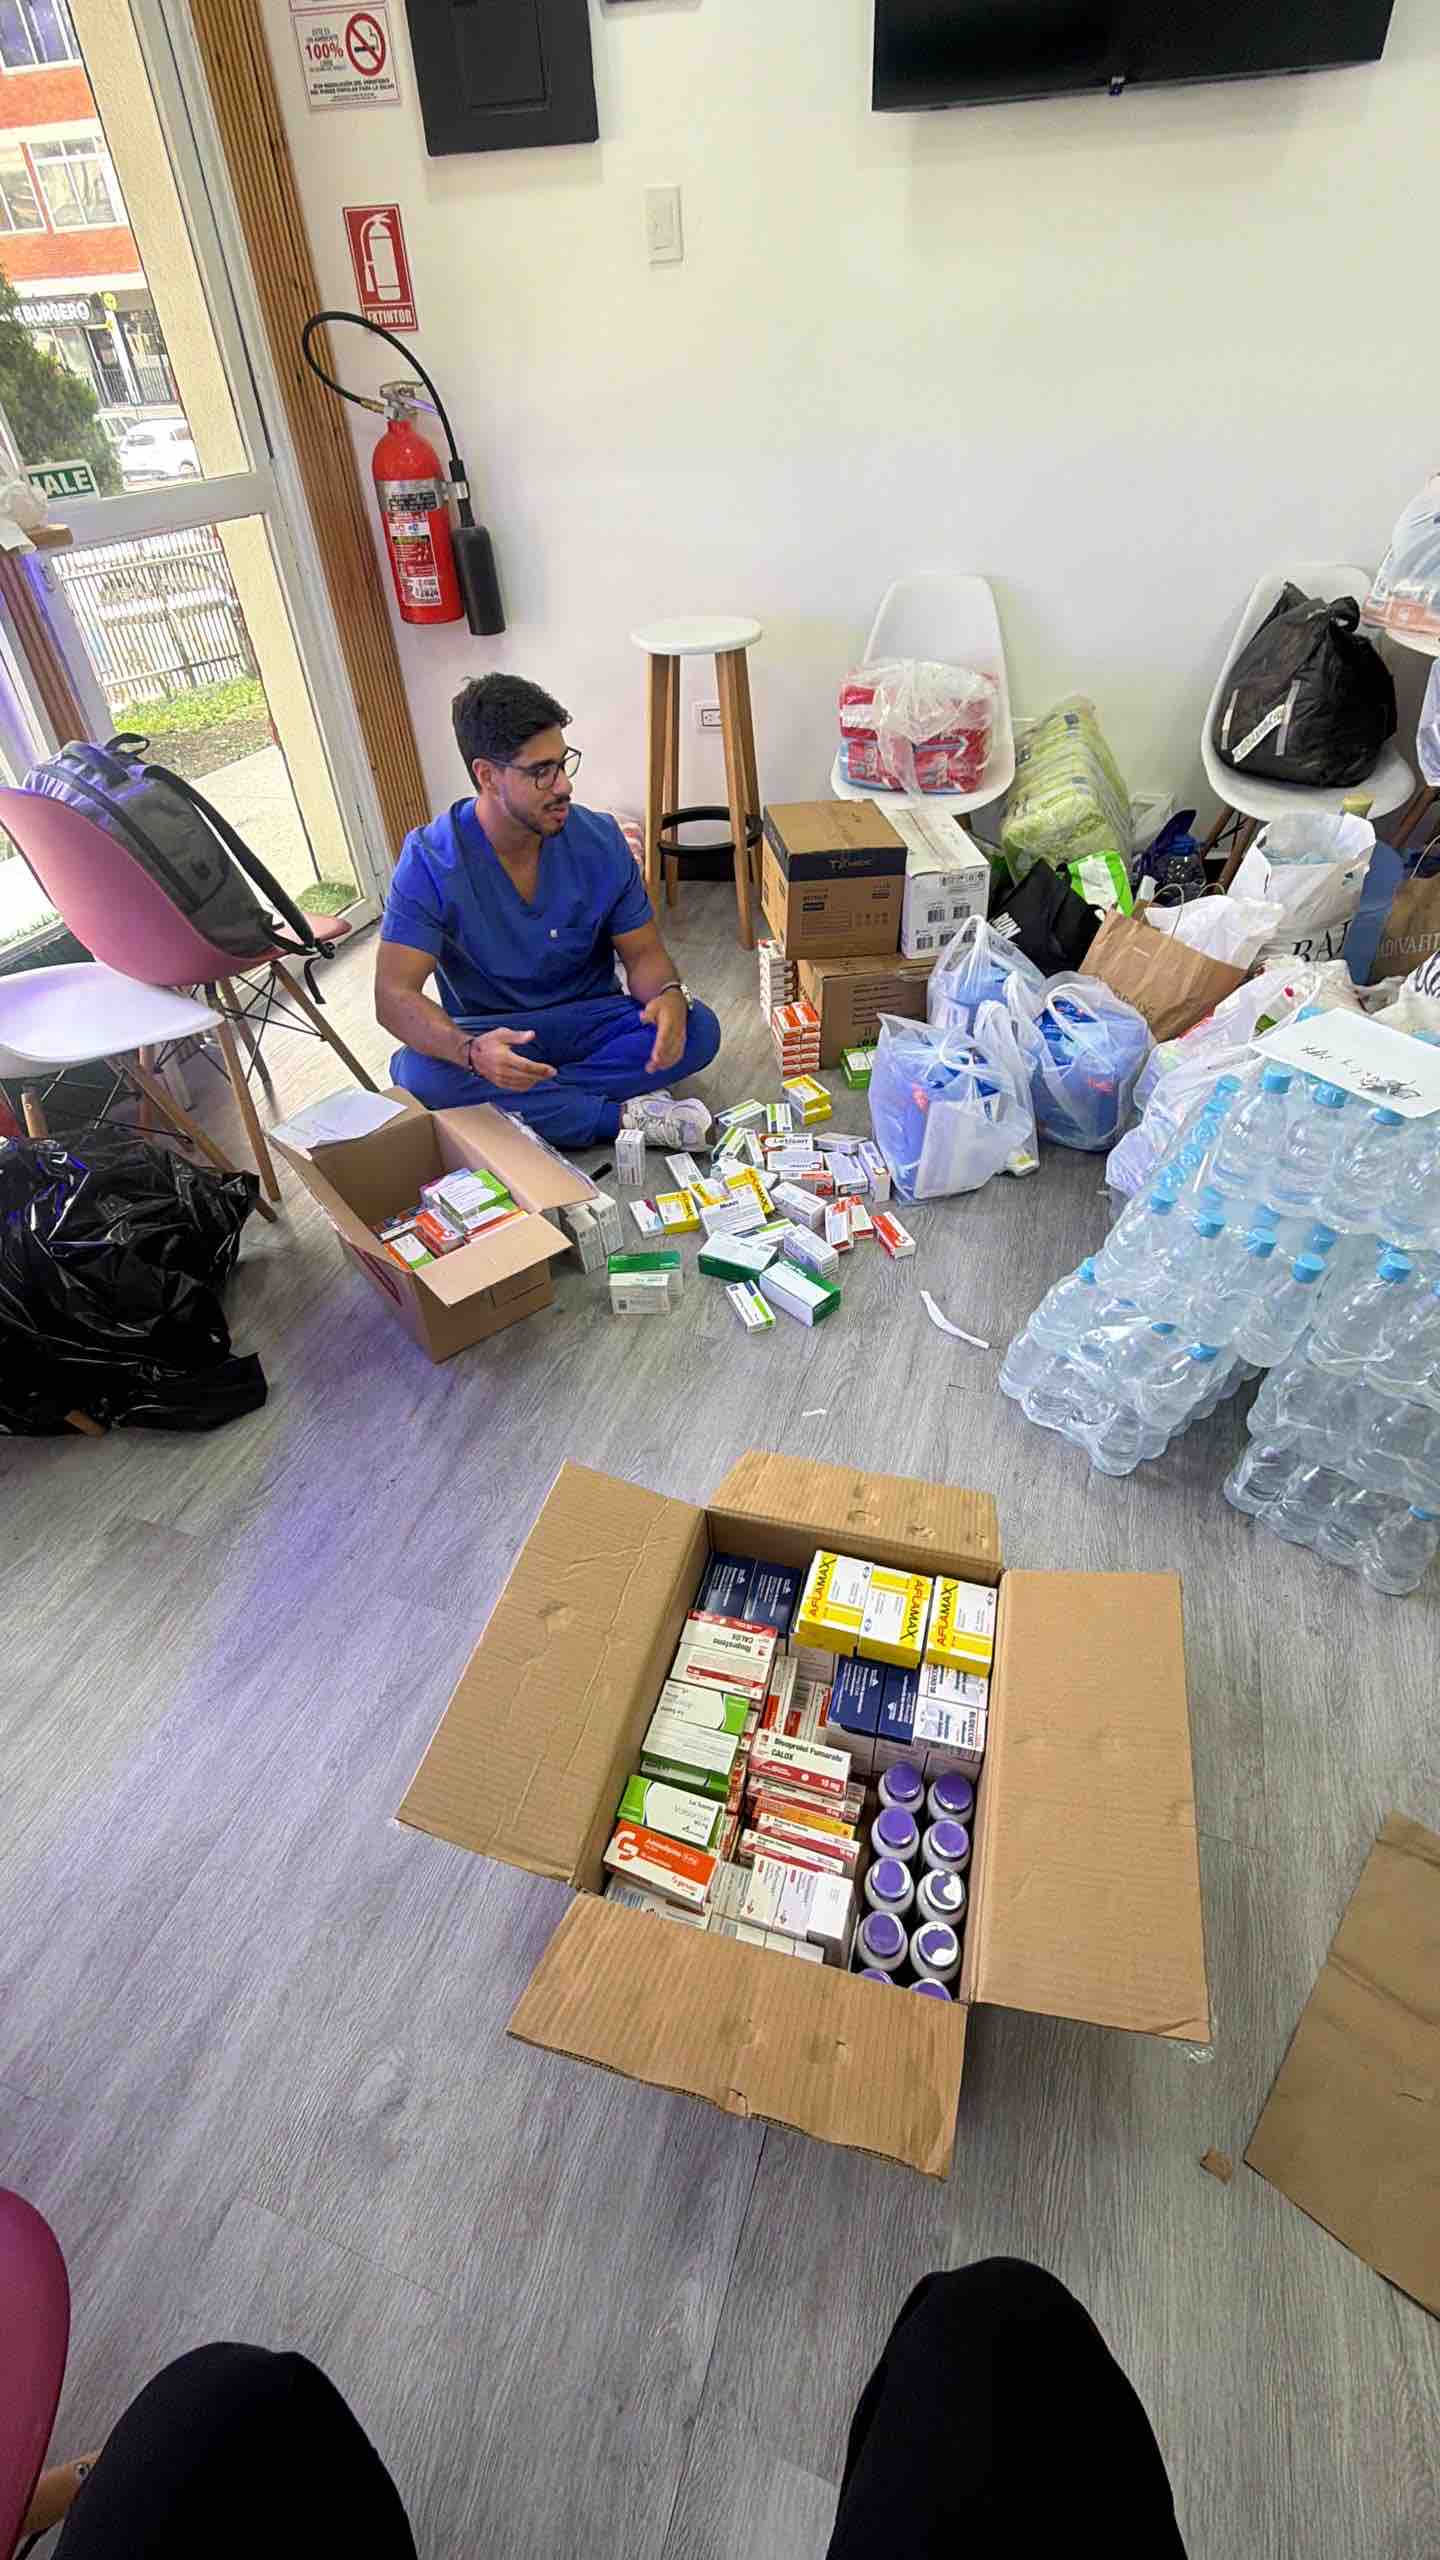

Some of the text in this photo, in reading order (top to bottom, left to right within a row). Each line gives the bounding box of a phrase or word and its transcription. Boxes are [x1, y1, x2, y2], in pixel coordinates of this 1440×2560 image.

[305, 41, 344, 60] 100%
[810, 1555, 837, 1618] AFLAMAX
[900, 1579, 924, 1641] AFLAMAX
[936, 1582, 960, 1647] AFLAMAX
[771, 1748, 793, 1761] CALOX
